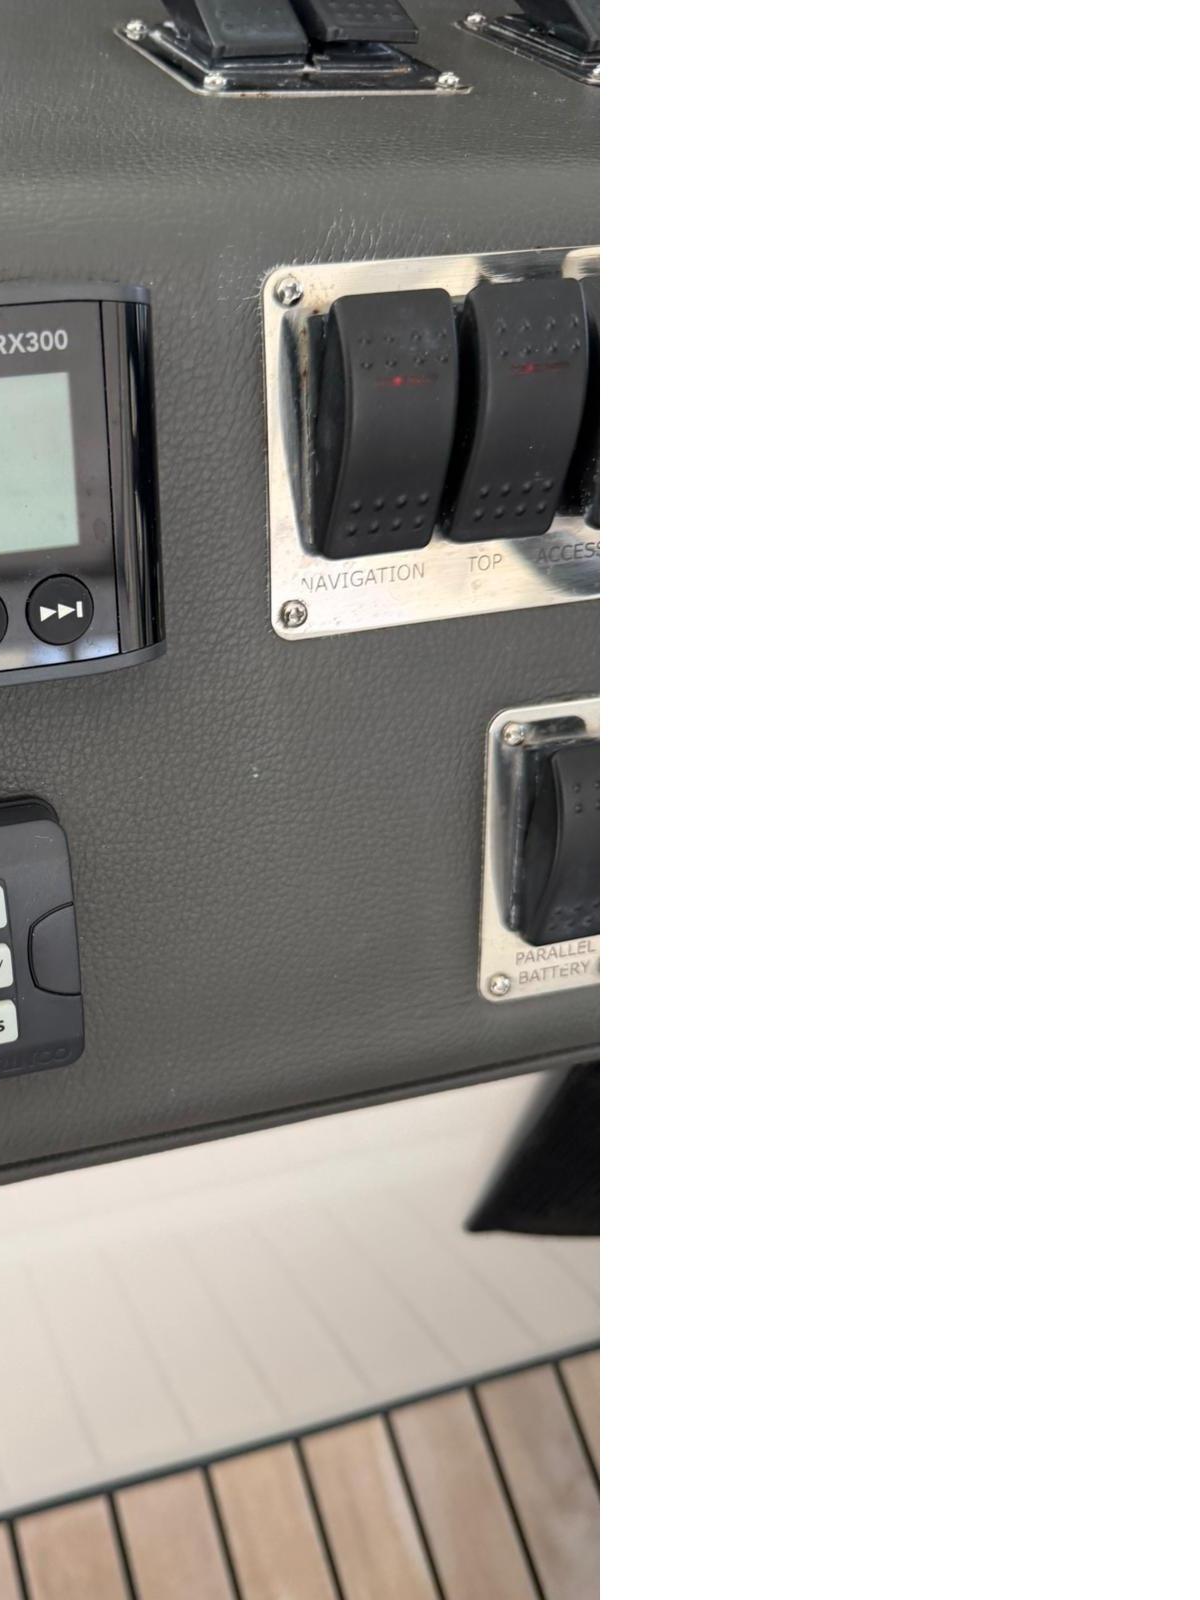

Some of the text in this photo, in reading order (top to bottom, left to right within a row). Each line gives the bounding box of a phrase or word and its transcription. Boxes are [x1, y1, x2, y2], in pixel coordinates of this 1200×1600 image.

[468, 554, 502, 572] TOP
[302, 564, 424, 591] NAVIGATION
[516, 940, 596, 965] PARALLEL
[519, 961, 589, 984] BATTERY
